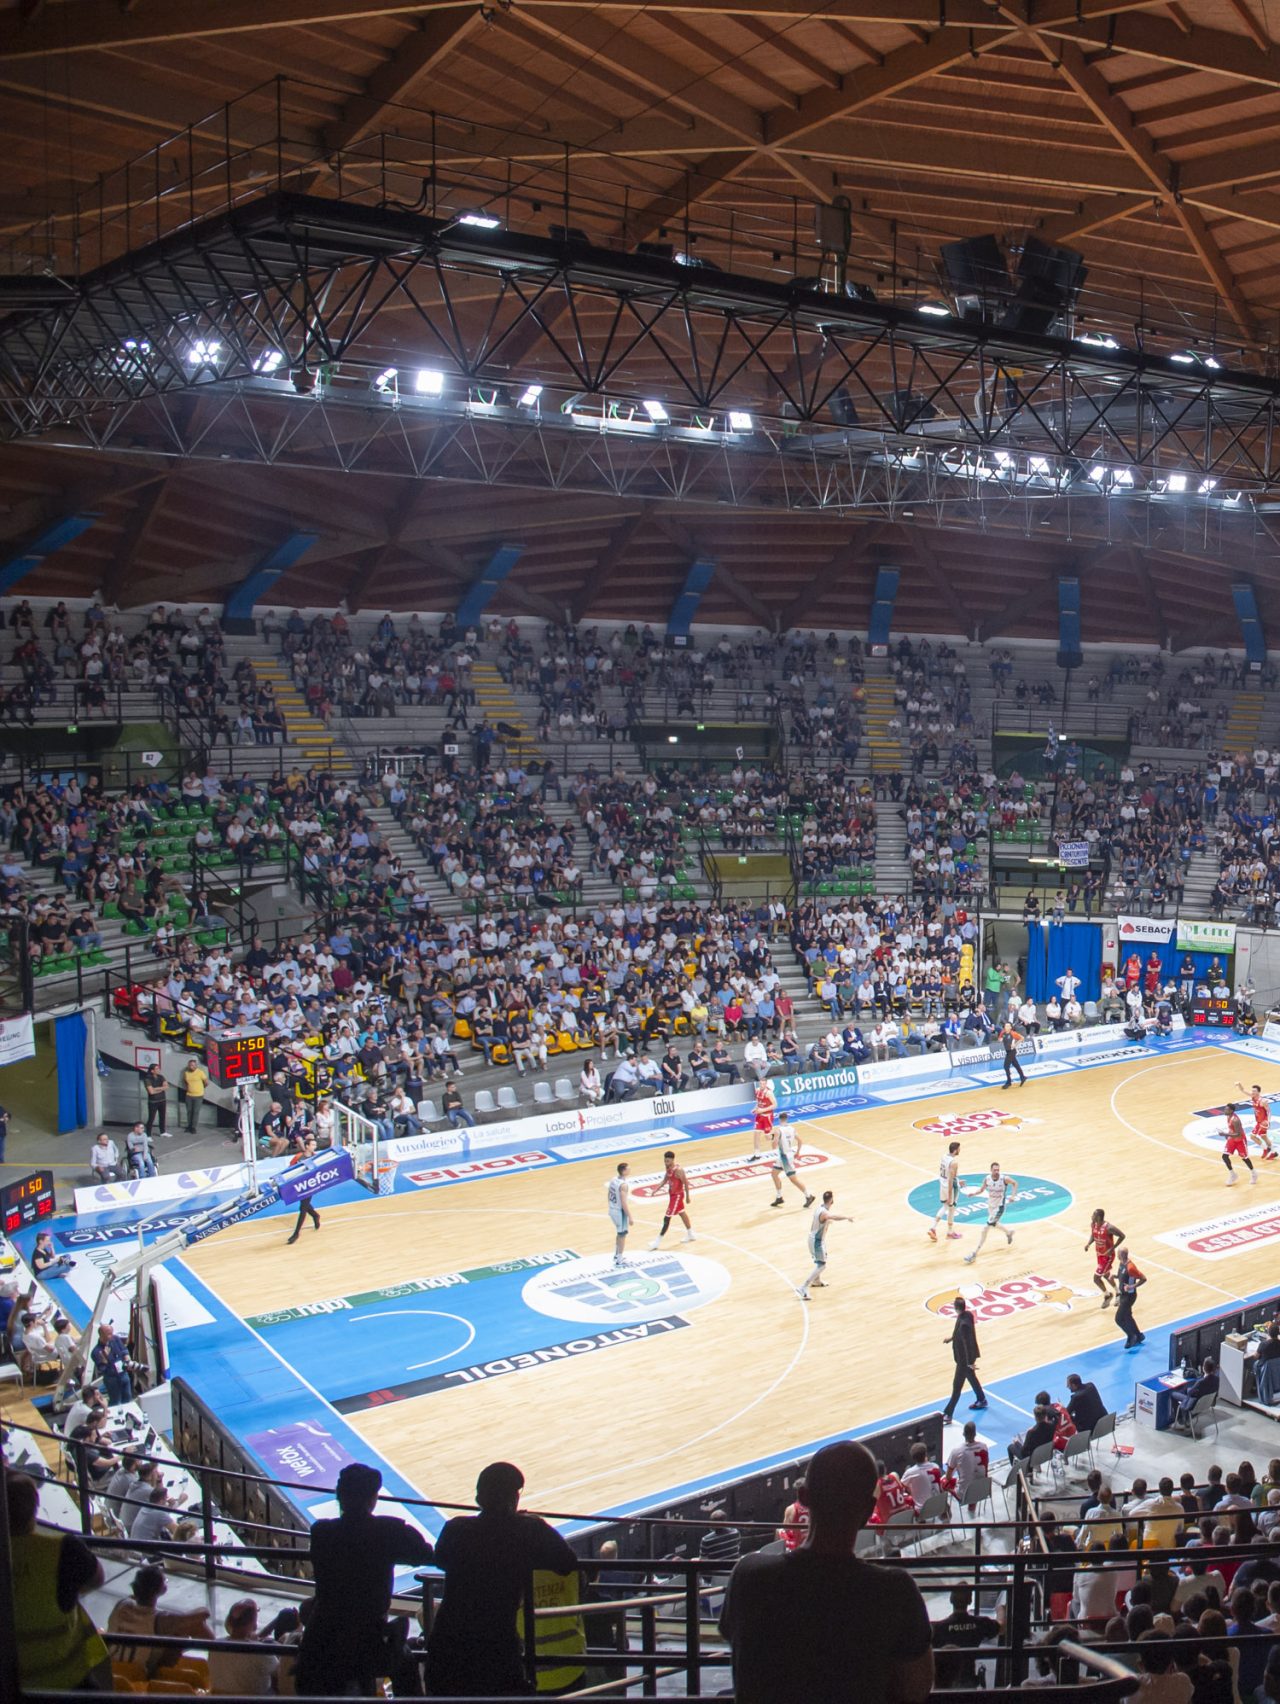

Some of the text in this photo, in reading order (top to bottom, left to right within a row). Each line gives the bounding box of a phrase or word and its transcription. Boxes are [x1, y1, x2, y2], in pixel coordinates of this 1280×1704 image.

[237, 1037, 265, 1052] 1:50
[225, 1050, 266, 1079] 20
[780, 1069, 856, 1096] S.Bernardo
[546, 1112, 623, 1132] Labor Project
[934, 1121, 994, 1138] FOX
[395, 1134, 457, 1153] Auxologico
[292, 1166, 340, 1193] wefox
[194, 1222, 221, 1242] NESSI
[230, 1195, 277, 1224] MAJOCCHI
[1196, 1227, 1259, 1253] WEST
[416, 1274, 470, 1293] tabu
[299, 1298, 353, 1318] tabu
[444, 1319, 675, 1383] LATTONEDIL
[276, 1445, 316, 1478] wefox
[885, 1489, 904, 1507] 16
